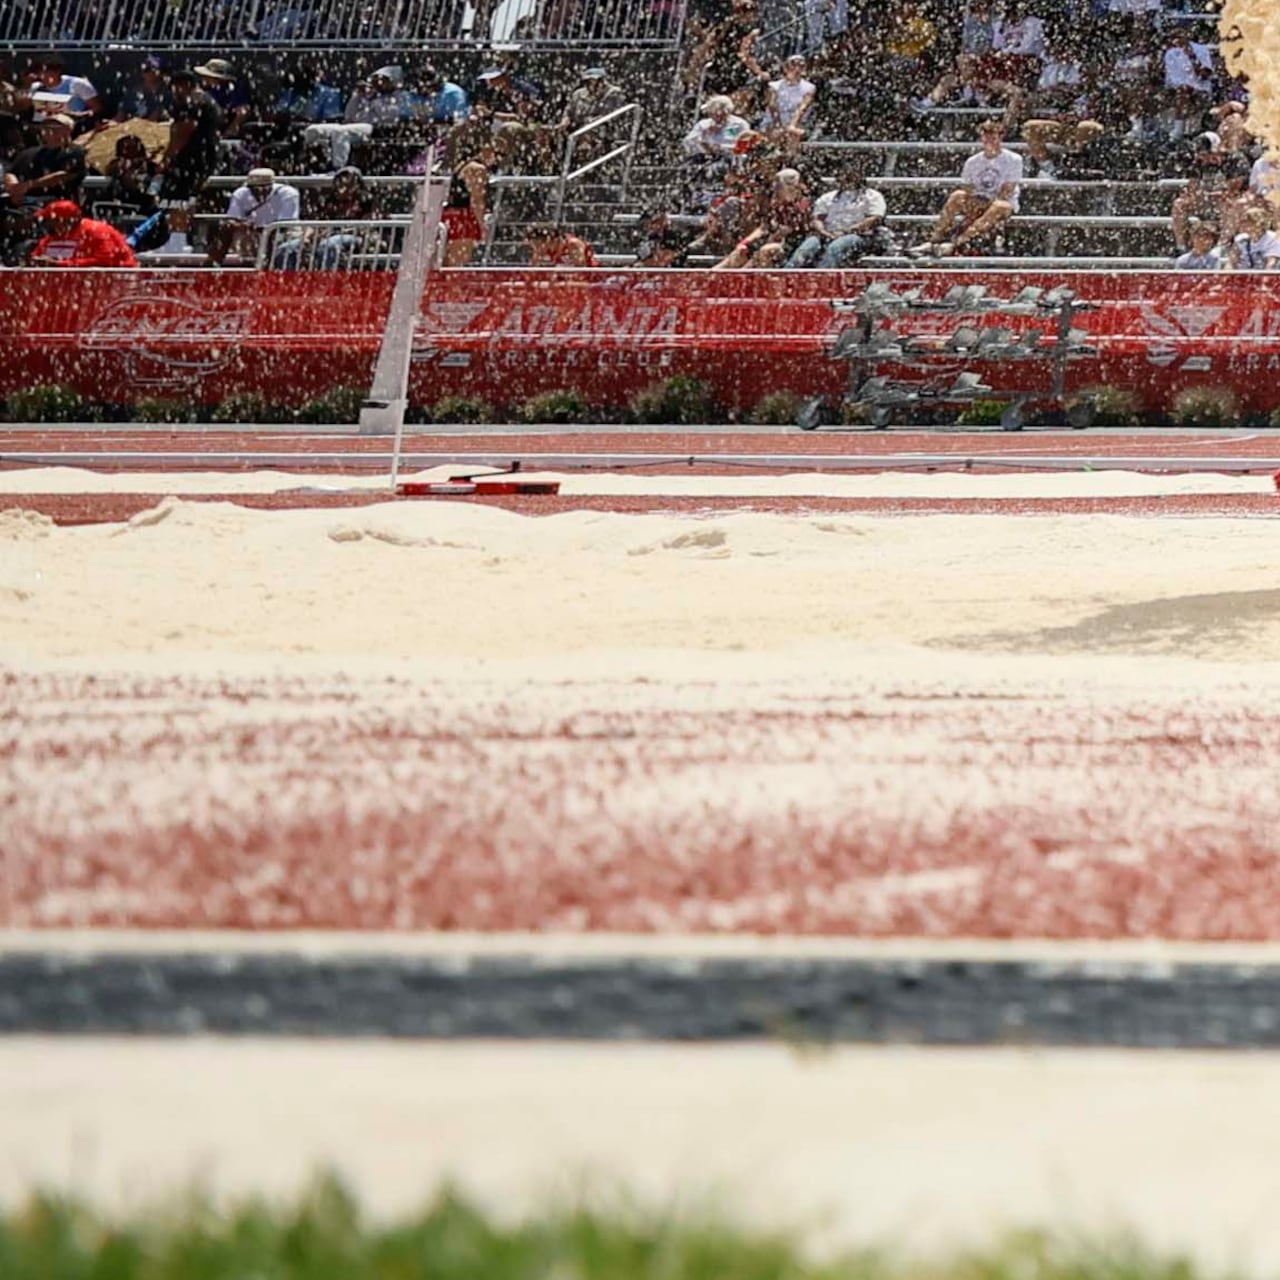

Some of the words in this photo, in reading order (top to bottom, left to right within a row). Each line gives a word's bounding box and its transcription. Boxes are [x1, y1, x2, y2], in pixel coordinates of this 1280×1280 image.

[490, 305, 680, 346] ATLANTA
[487, 349, 578, 368] TRACK
[598, 349, 674, 368] CLUB
